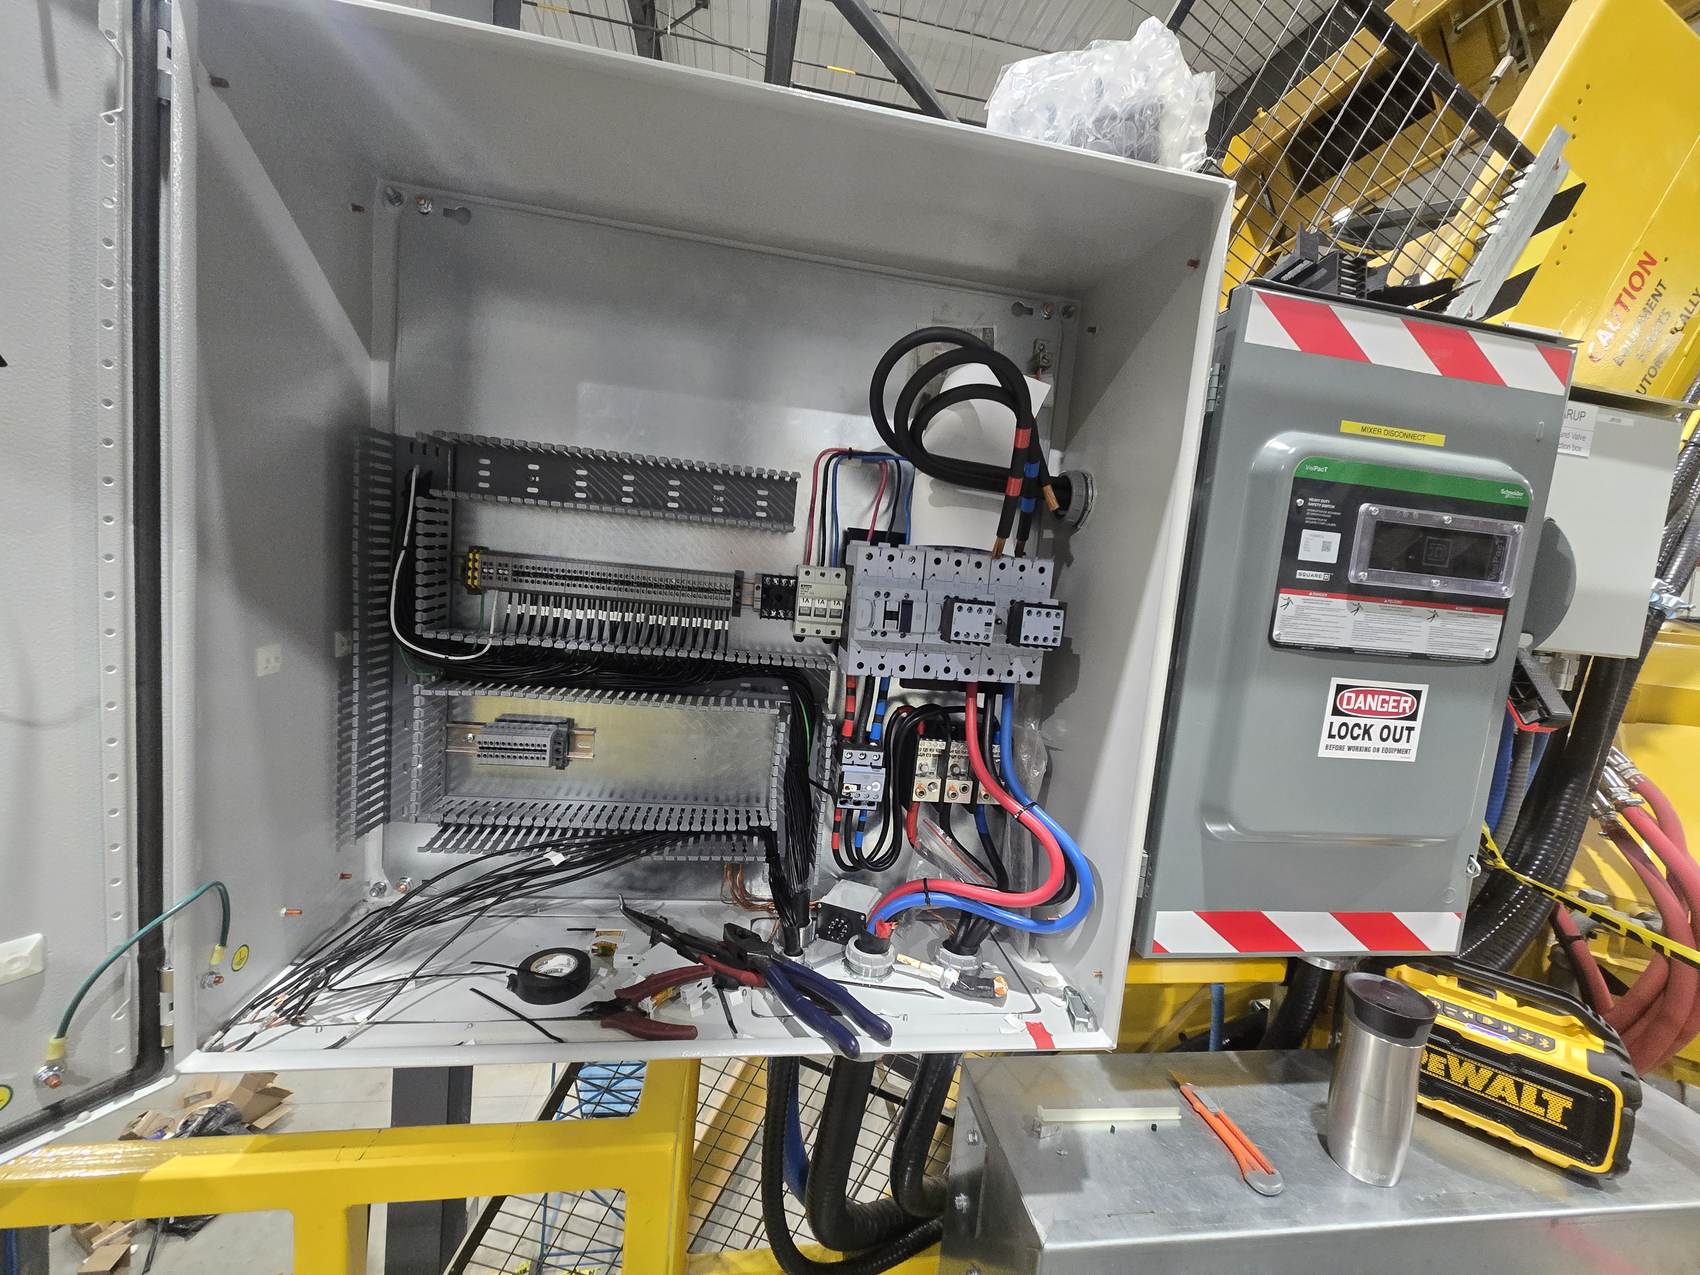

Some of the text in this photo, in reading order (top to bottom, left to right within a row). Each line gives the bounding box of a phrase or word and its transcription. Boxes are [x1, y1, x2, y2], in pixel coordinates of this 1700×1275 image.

[1587, 250, 1658, 363] CAUTION
[1564, 408, 1586, 422] RUP
[1360, 426, 1426, 441] MIXER DISCONNECT
[1342, 692, 1412, 713] DANGER
[1327, 721, 1415, 743] LOCK OUT
[1325, 744, 1346, 752] BEFORE
[1347, 745, 1371, 753] WORKING
[1381, 747, 1412, 755] EQUIPMENT
